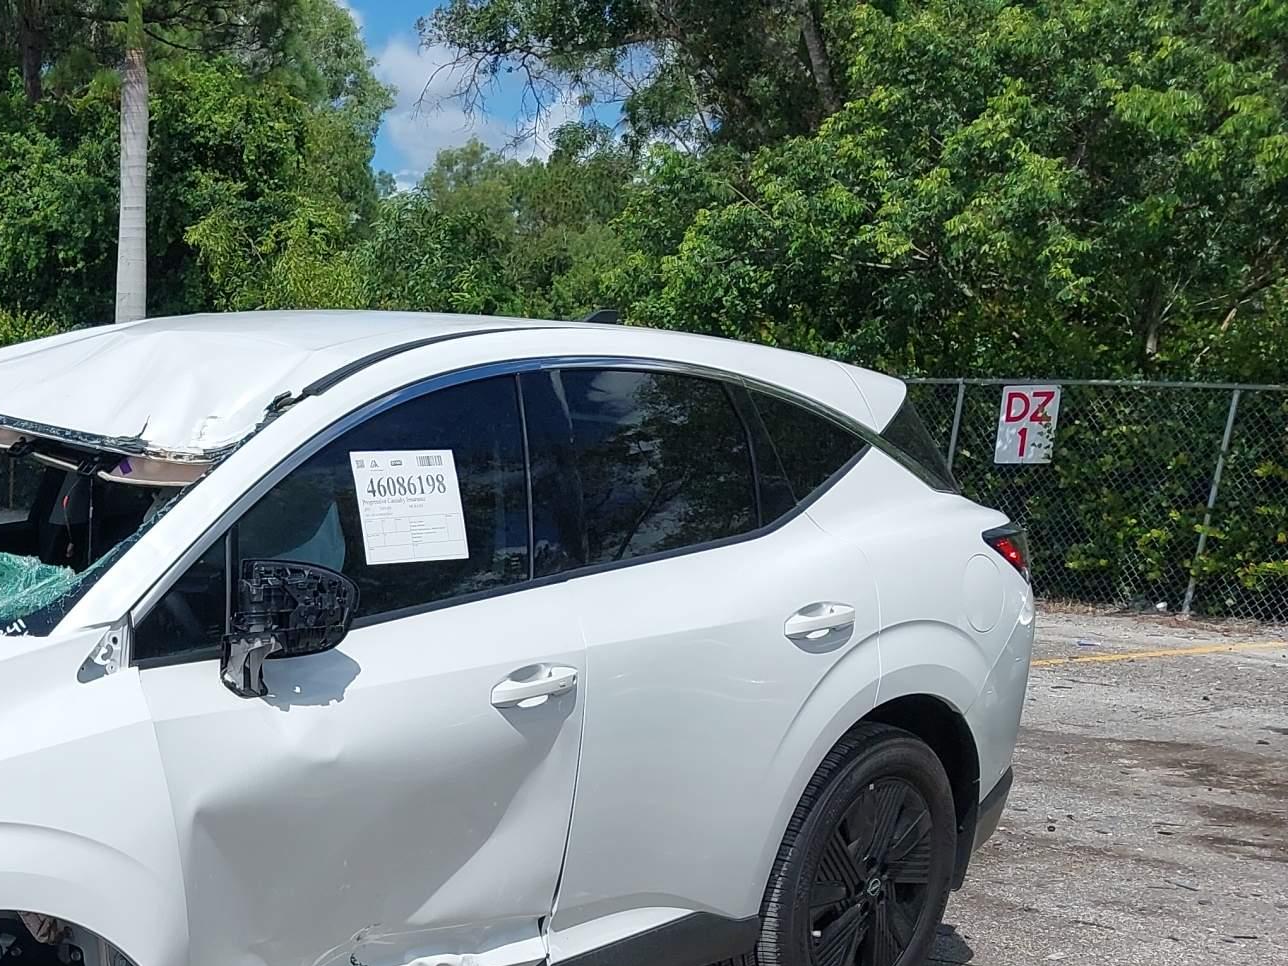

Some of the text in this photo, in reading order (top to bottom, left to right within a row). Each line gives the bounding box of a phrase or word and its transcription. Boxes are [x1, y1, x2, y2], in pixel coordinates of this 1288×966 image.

[1004, 391, 1056, 423] DZ
[1017, 427, 1028, 458] 1
[366, 473, 447, 498] 46086198
